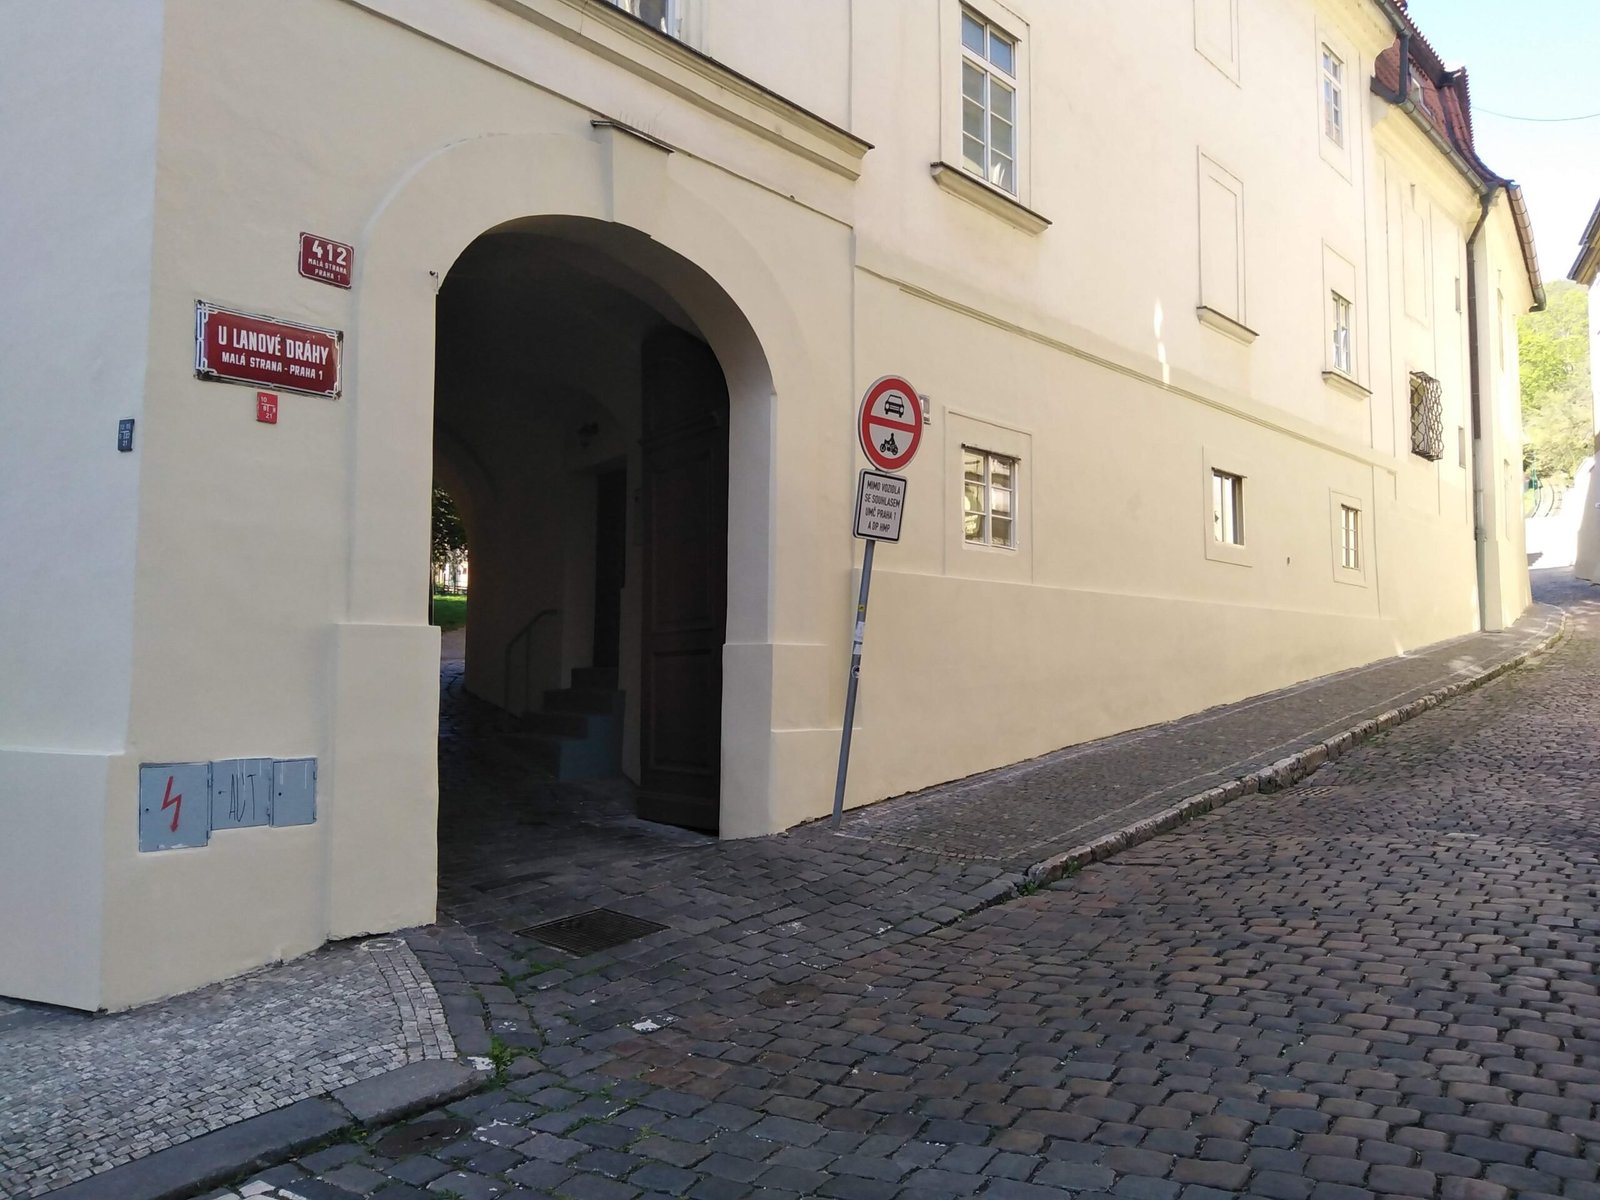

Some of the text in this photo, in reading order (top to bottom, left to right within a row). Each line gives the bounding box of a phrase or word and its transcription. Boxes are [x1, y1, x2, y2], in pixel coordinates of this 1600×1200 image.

[312, 240, 347, 266] 412
[218, 325, 329, 365] U LANOVÉ DRÁHY
[222, 352, 246, 366] MALÁ
[250, 357, 283, 373] STRANA
[290, 364, 316, 379] PRAHA
[318, 370, 323, 380] 1
[867, 480, 901, 495] MIMO VOZIDLA
[864, 493, 901, 508] SE SOUHLASEM
[877, 509, 892, 520] PRAHA
